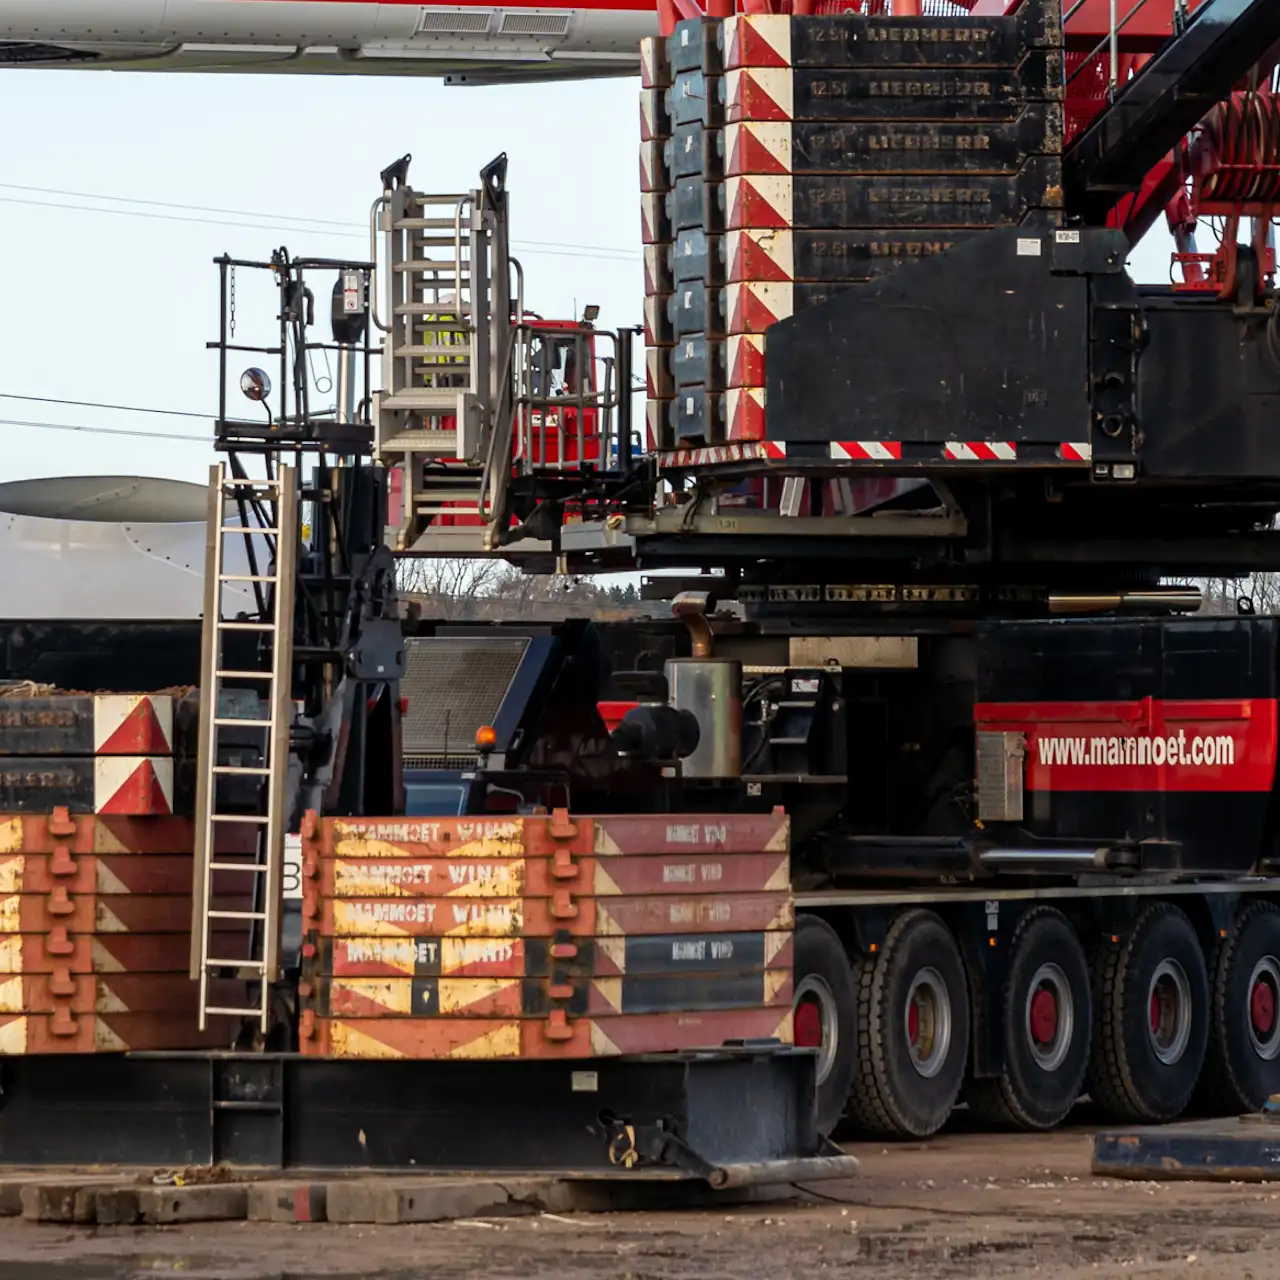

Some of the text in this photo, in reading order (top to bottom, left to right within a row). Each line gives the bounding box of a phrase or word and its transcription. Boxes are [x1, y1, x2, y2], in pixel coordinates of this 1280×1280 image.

[867, 27, 989, 42] LIEBHERR
[869, 81, 991, 96] LIEBHERR
[869, 134, 990, 150] LIEBHERR
[869, 187, 991, 203] LIEBHERR
[1038, 729, 1235, 766] www.mammoet.com
[348, 822, 519, 842] MAMMOET WIND
[343, 864, 434, 884] MAMMOET
[345, 903, 512, 924] MAMMOET WIND
[347, 943, 438, 963] MAMMOET
